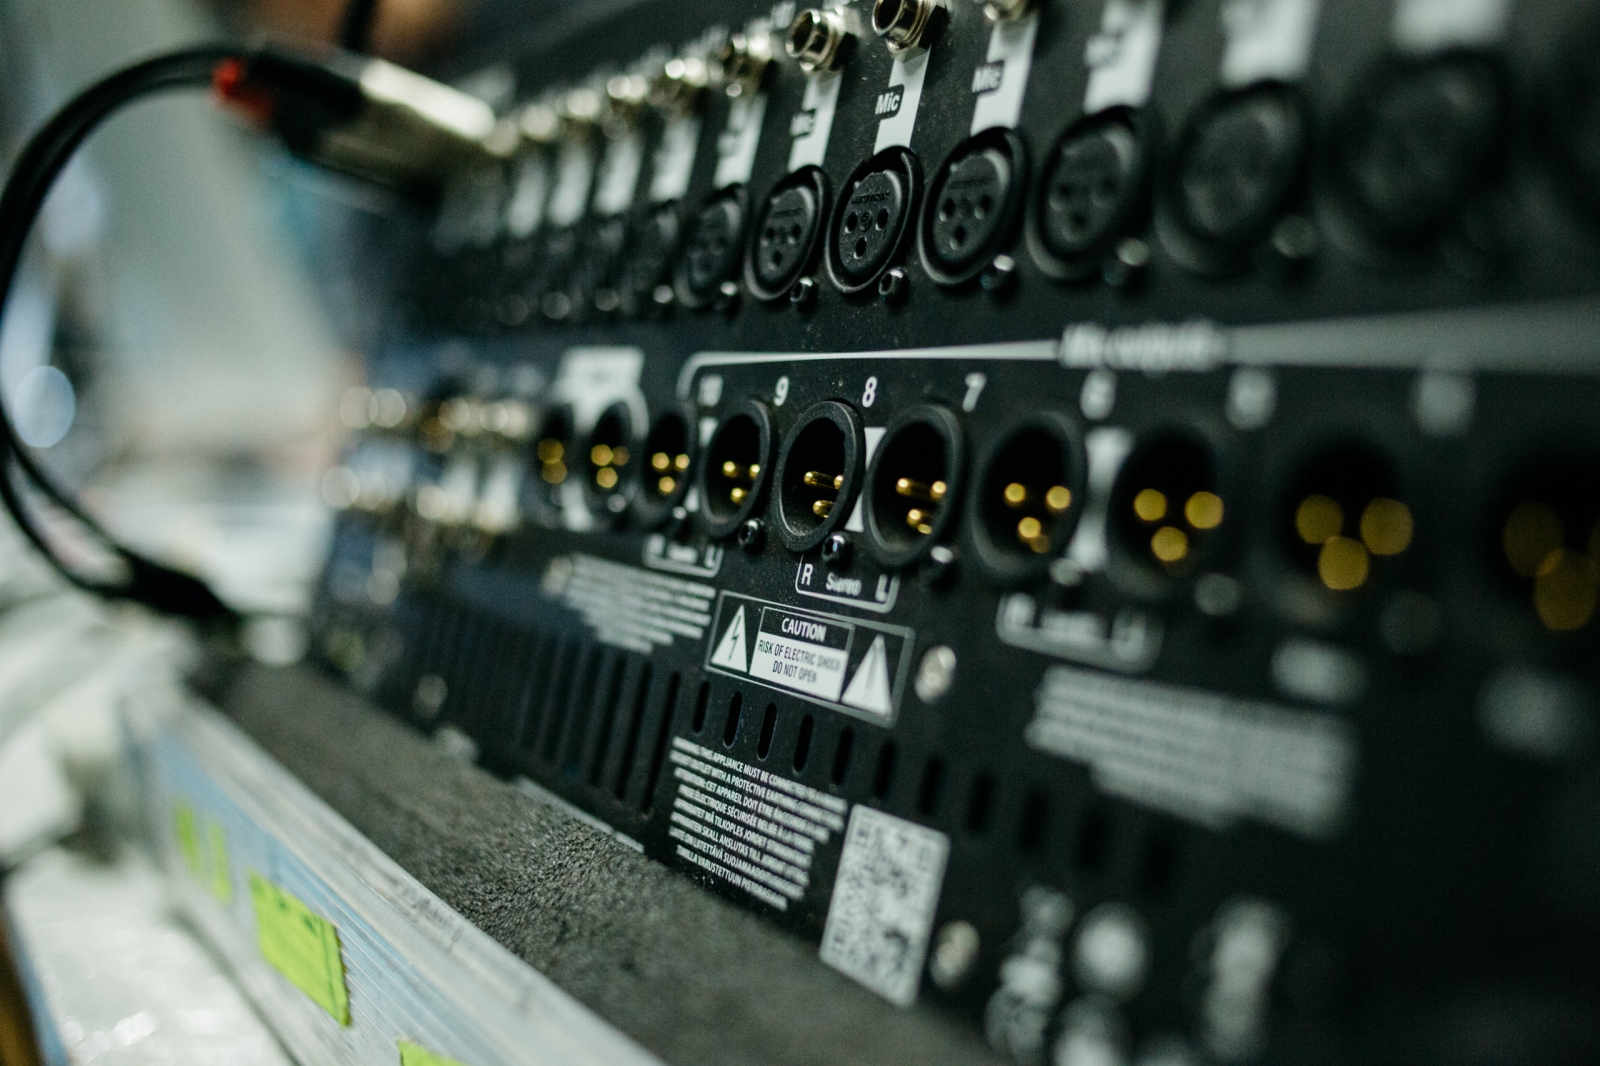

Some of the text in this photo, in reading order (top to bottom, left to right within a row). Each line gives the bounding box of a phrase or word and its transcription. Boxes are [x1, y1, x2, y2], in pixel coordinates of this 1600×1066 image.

[875, 92, 900, 115] Mic
[774, 375, 790, 406] 9
[861, 375, 878, 408] 8
[962, 372, 987, 412] 7
[801, 563, 813, 586] R
[781, 617, 827, 643] CAUTION
[757, 639, 774, 655] RISK
[774, 643, 784, 657] OF
[783, 646, 817, 666] ELECTRIC
[772, 660, 818, 683] DO NOT OPEN
[711, 766, 726, 781] WITH
[725, 772, 730, 783] A
[731, 774, 766, 798] PROTECTIVE
[712, 751, 743, 772] APPLIANCE
[742, 763, 760, 779] MUST
[760, 770, 769, 783] BE
[716, 784, 742, 804] APPAREIL
[742, 795, 758, 811] DOIT
[726, 804, 757, 828] SÉCURISÉE
[702, 825, 718, 842] SKALL
[718, 833, 748, 857] ANSLUTAS
[748, 846, 760, 862] TILL
[714, 815, 743, 837] TILKOPLES
[743, 828, 767, 849] JORDET
[696, 855, 741, 886] VARUSTETTUUN
